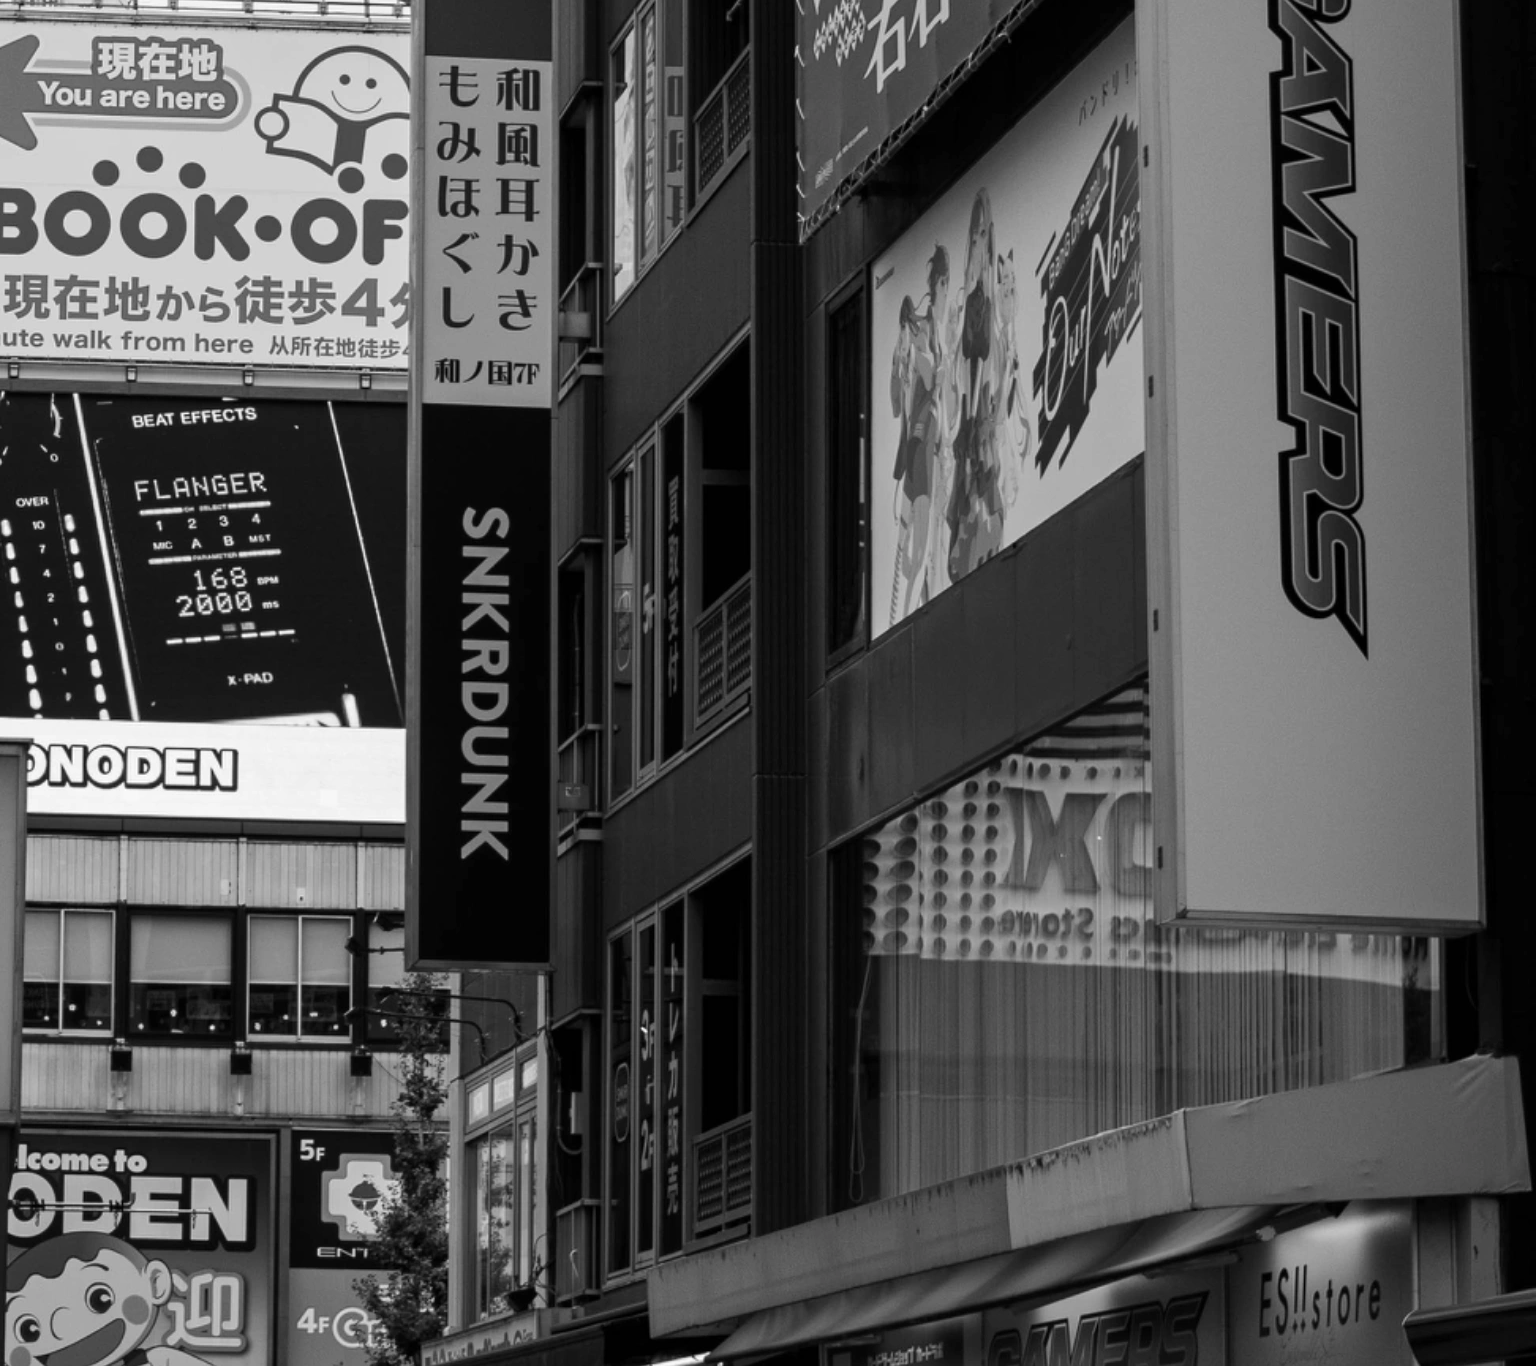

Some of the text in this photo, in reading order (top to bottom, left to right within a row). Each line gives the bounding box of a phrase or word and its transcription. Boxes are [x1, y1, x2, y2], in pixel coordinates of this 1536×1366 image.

[96, 41, 220, 83] 現在地
[38, 81, 225, 111] You are here
[435, 64, 482, 332] もみほぐし
[494, 65, 542, 332] 和風耳かき
[52, 327, 113, 351] walk
[121, 329, 187, 352] from
[193, 332, 254, 355] here
[132, 407, 257, 428] BEAT EFFECTS
[134, 471, 268, 502] FLANGER
[15, 496, 50, 508] OVER
[32, 520, 46, 531] 10
[155, 513, 262, 532] 1 2 3 4
[191, 538, 203, 550] A
[223, 535, 234, 547] B
[193, 566, 249, 591] 168
[175, 590, 253, 617] 2000
[460, 506, 512, 862] SNKRDUNK
[14, 1144, 148, 1174] lcome to
[299, 1139, 325, 1161] 5F
[297, 1306, 331, 1335] 4F
